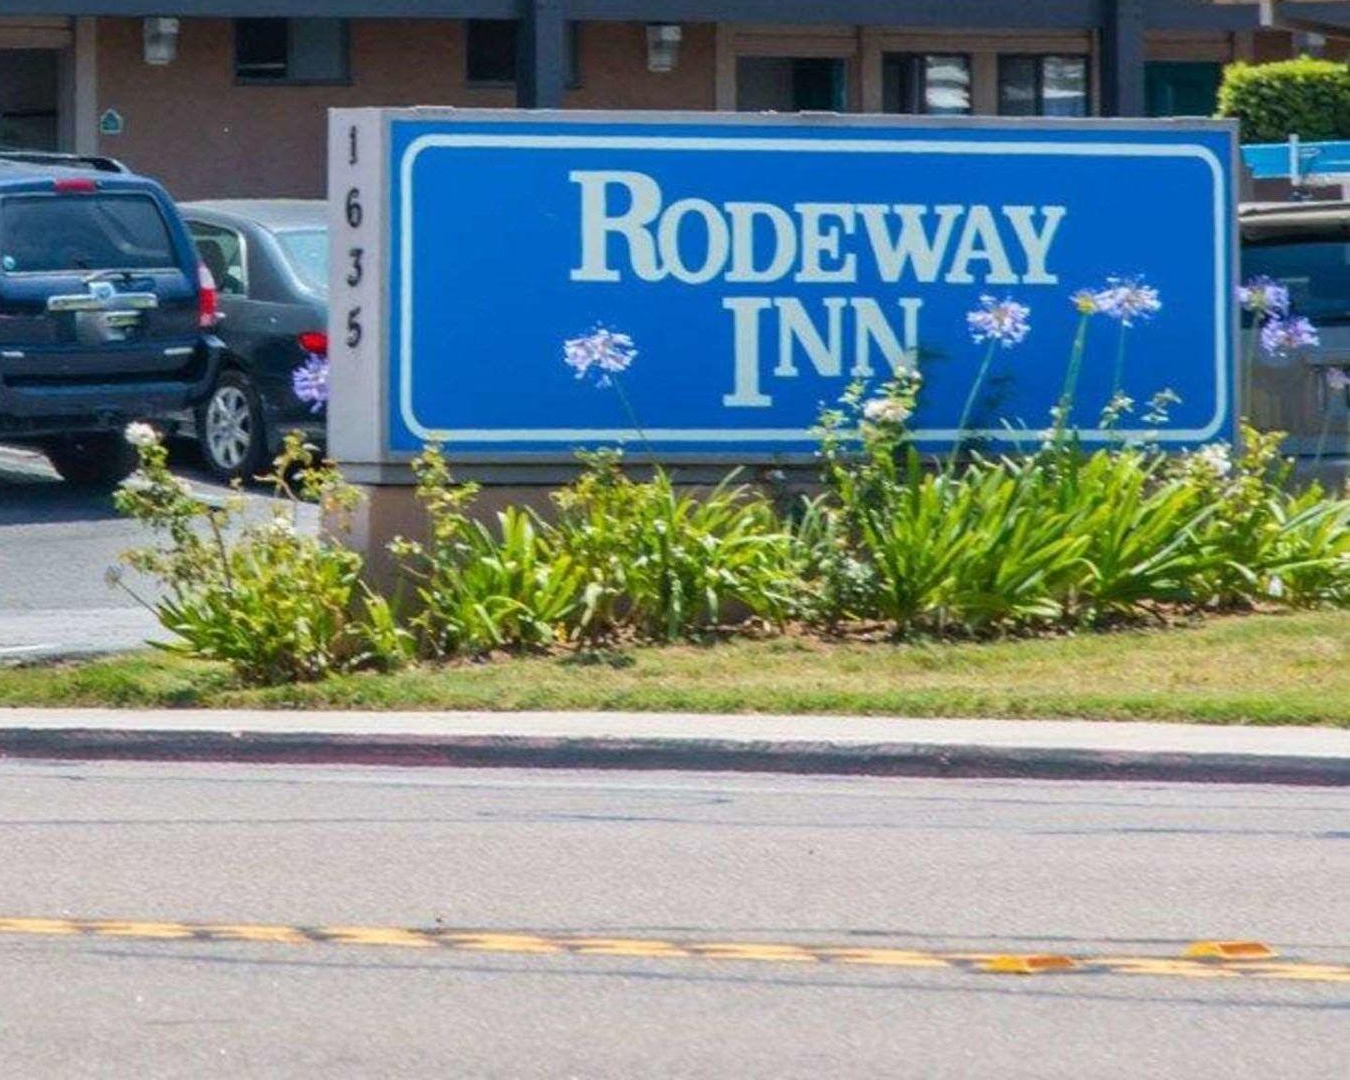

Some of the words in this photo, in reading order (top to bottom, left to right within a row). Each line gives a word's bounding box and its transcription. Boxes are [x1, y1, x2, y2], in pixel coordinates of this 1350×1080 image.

[344, 125, 364, 349] 1635
[570, 170, 1065, 284] RODEWAY
[722, 297, 922, 407] INN
